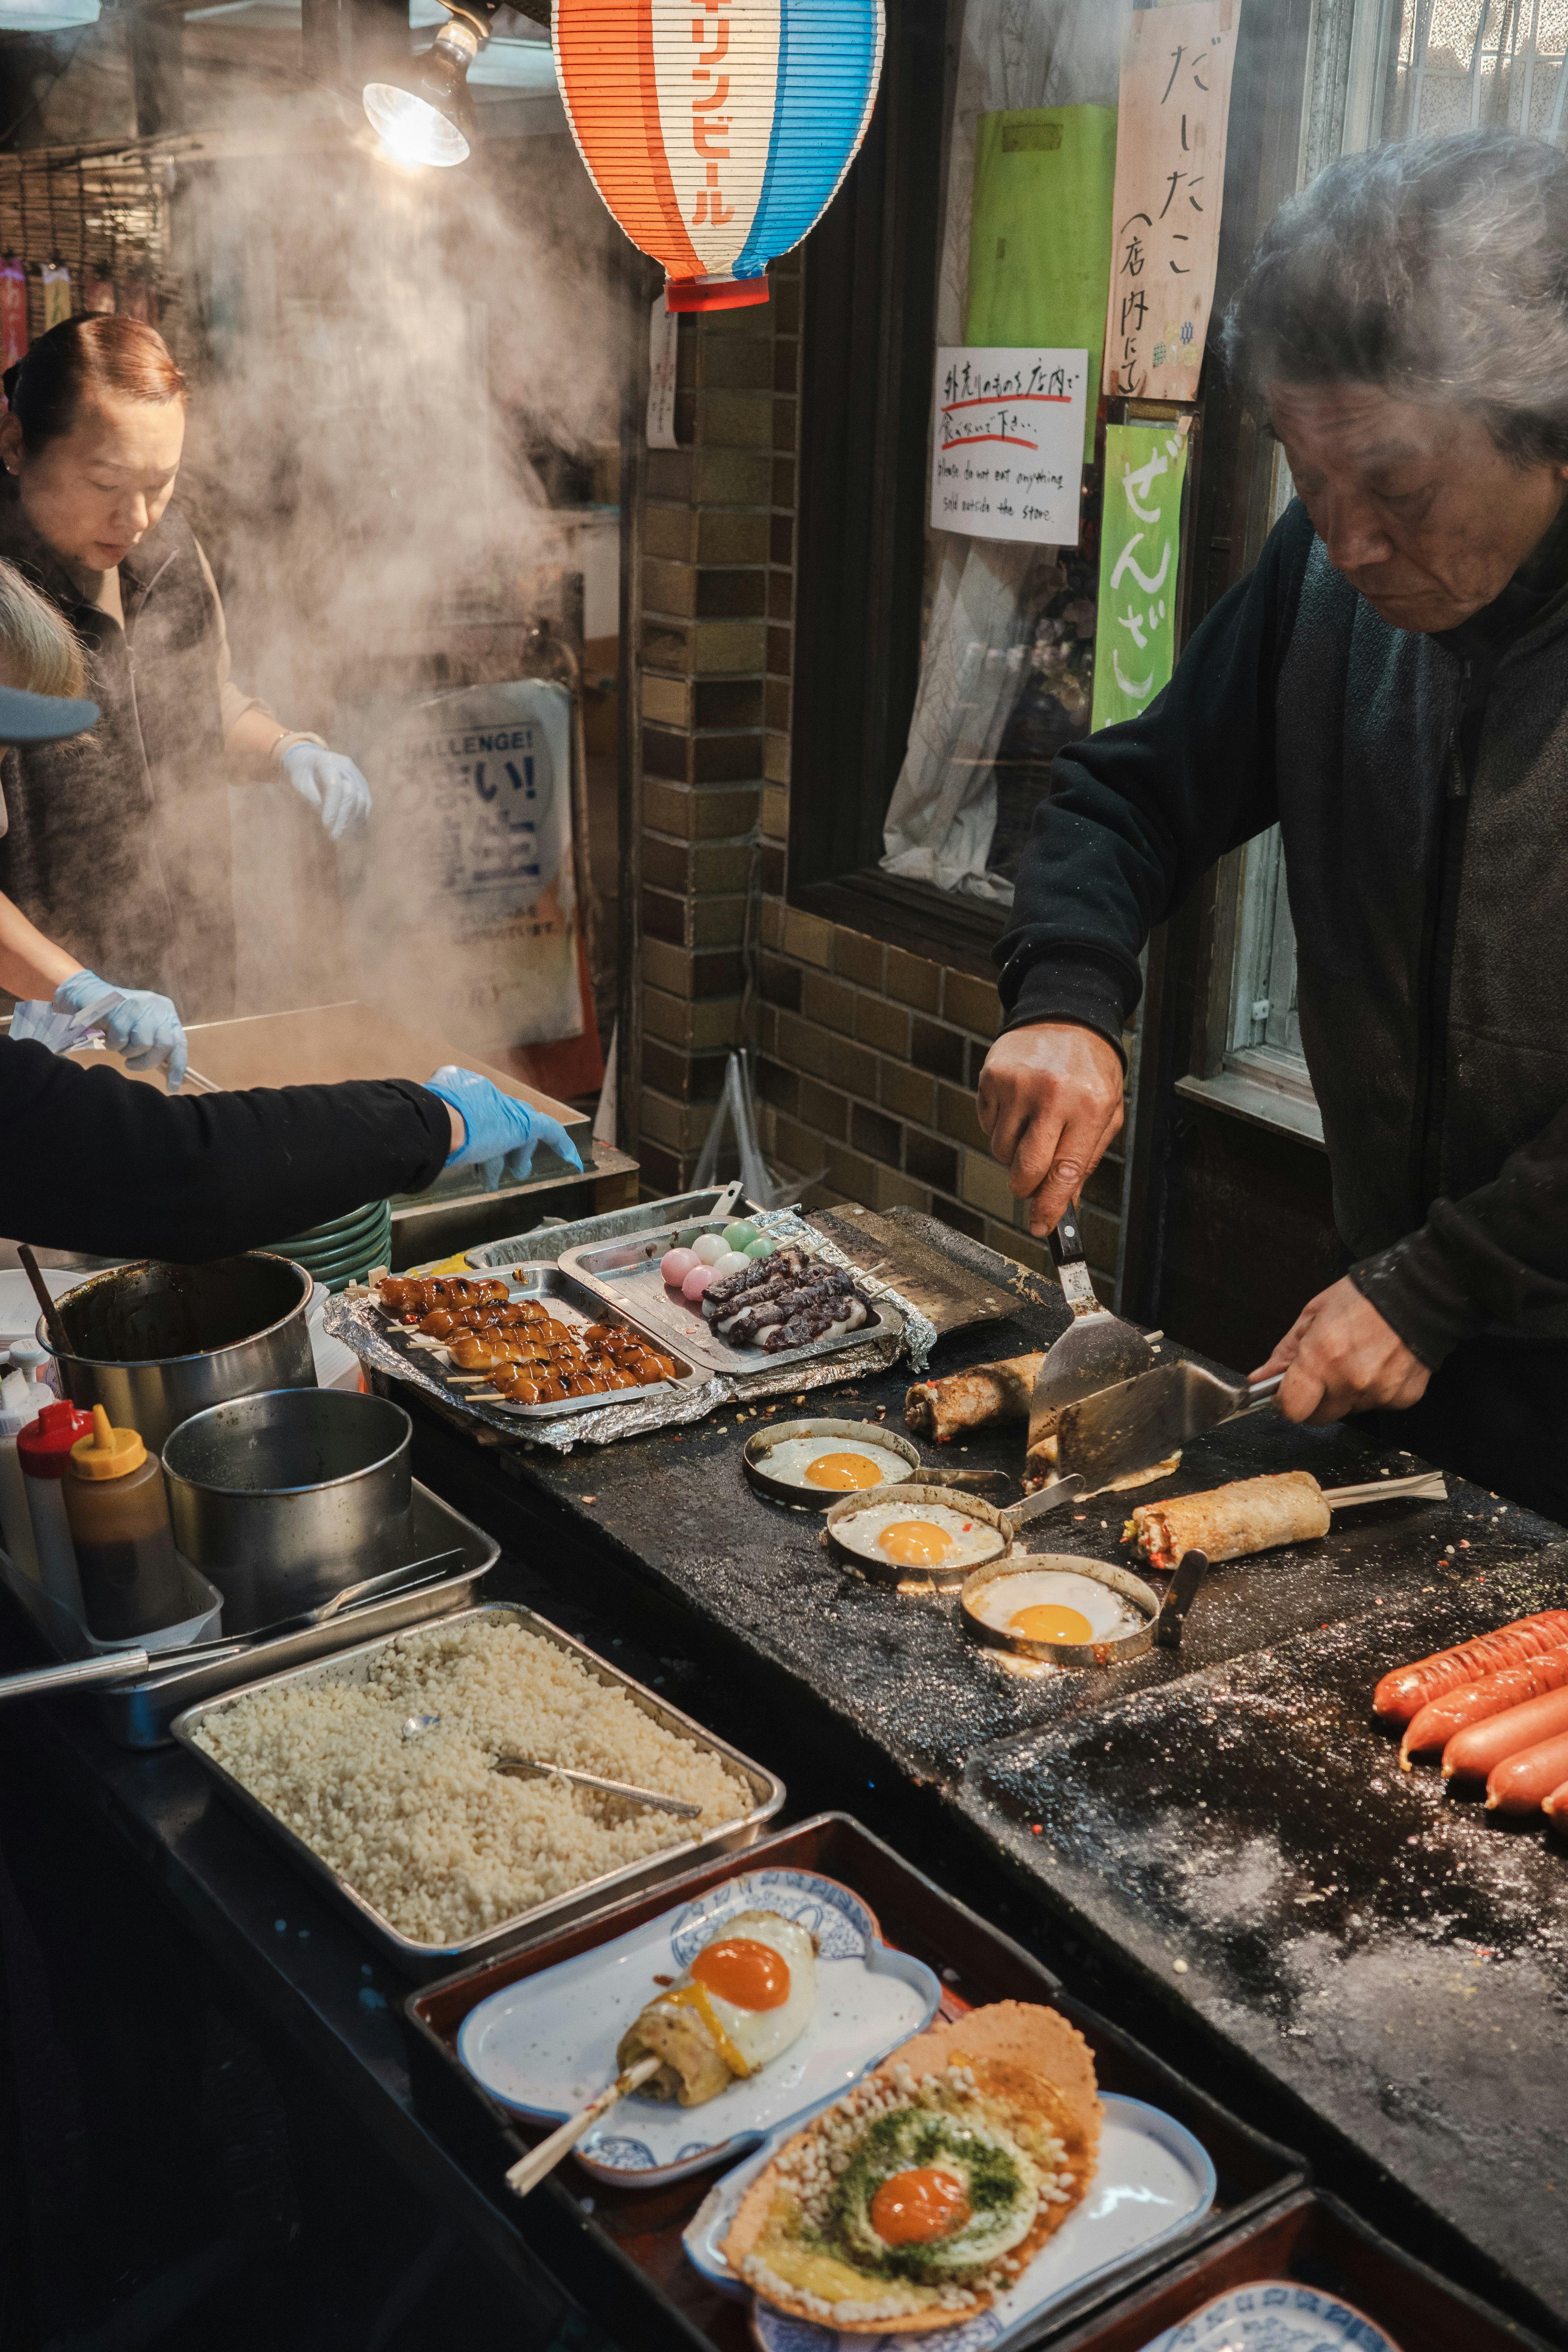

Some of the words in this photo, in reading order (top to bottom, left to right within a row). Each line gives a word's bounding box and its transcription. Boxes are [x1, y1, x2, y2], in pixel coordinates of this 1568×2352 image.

[1160, 36, 1221, 274] だしたこ
[994, 468, 1011, 483] eat
[1016, 468, 1064, 494] anything
[996, 497, 1014, 516] the
[1105, 434, 1182, 727] ぜんざ
